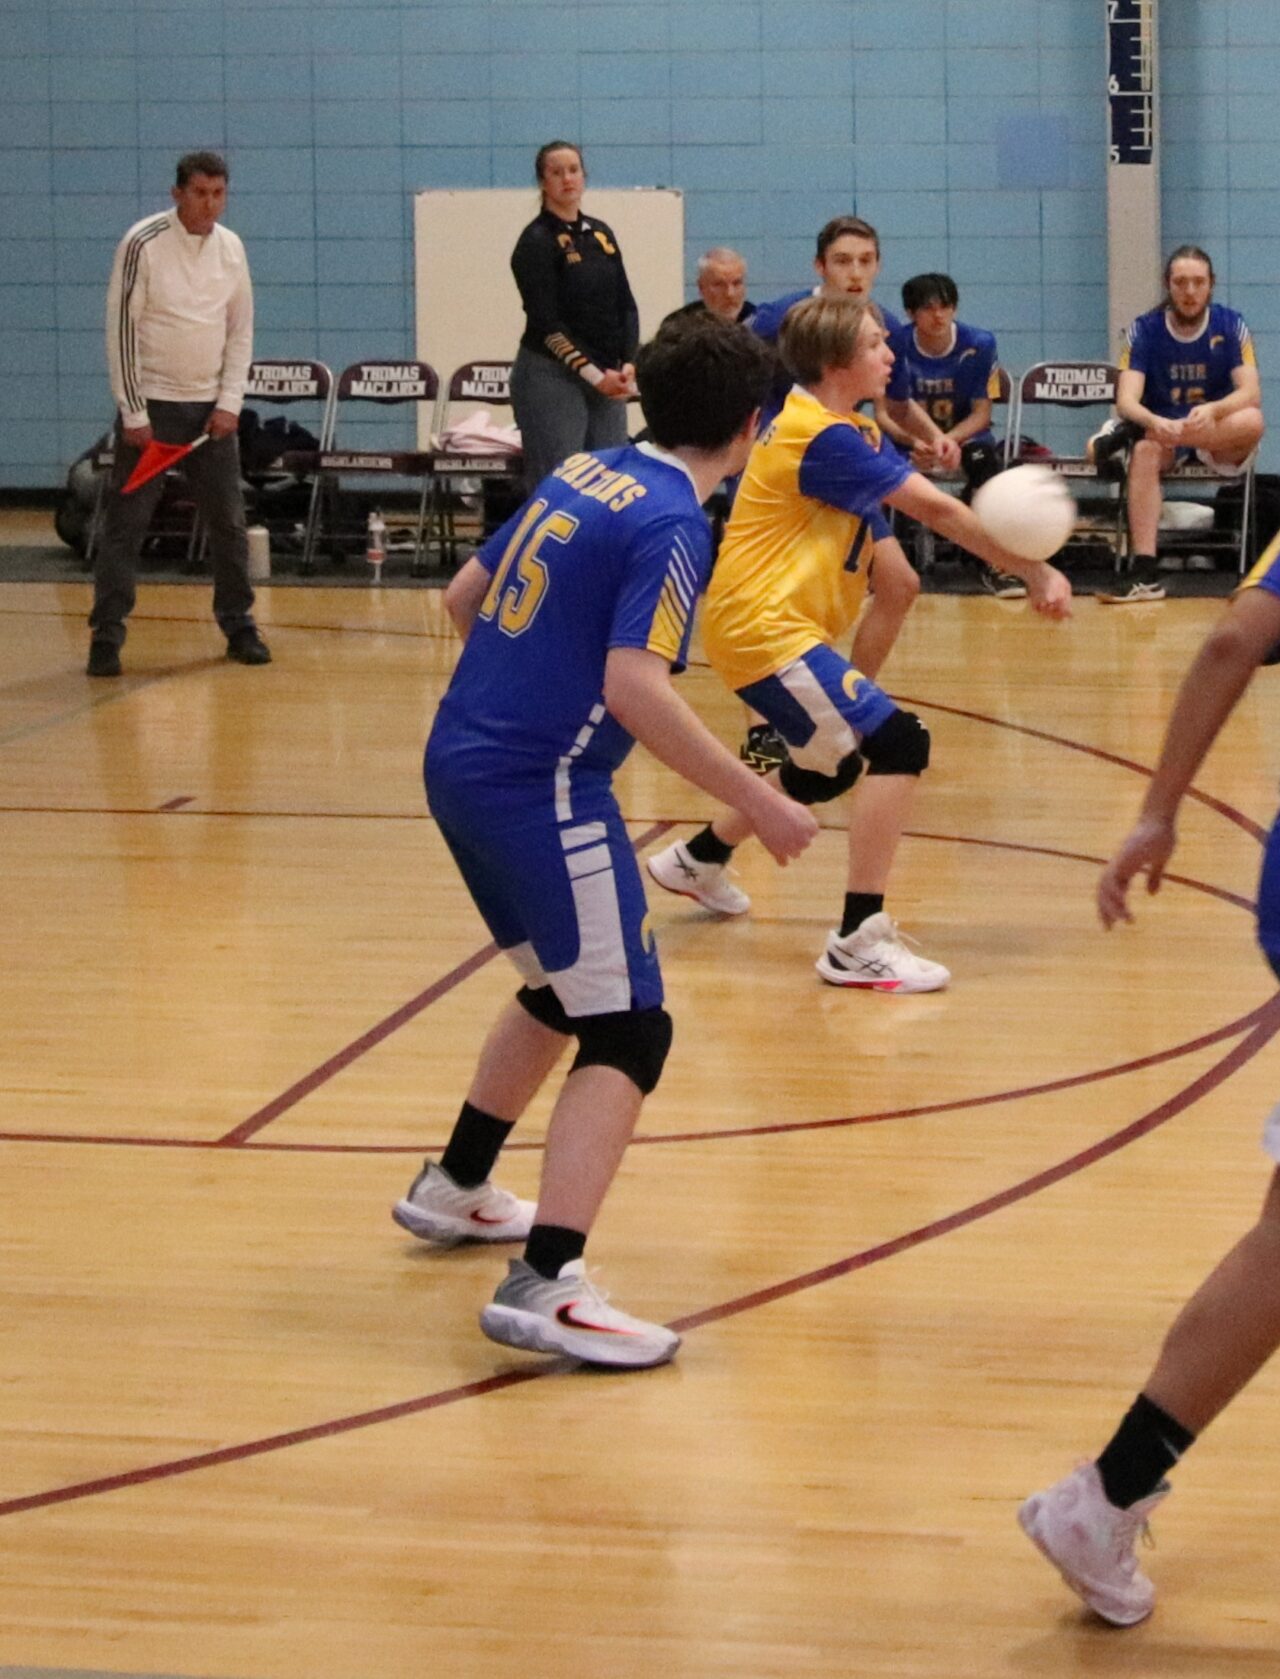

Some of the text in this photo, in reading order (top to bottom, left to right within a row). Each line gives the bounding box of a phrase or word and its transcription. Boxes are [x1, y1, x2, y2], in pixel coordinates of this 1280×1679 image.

[1108, 1, 1119, 20] 7
[1108, 74, 1120, 94] 6
[1110, 146, 1120, 163] 5
[253, 365, 312, 380] THOMAS
[361, 365, 420, 381] THOMAS
[472, 366, 512, 381] THOM
[1045, 368, 1107, 384] THOMAS
[245, 380, 318, 395] MACLAREN
[351, 381, 426, 397] MACLAREN
[461, 381, 511, 398] MACLA
[1035, 383, 1115, 400] MACLAREN
[478, 498, 580, 638] 15
